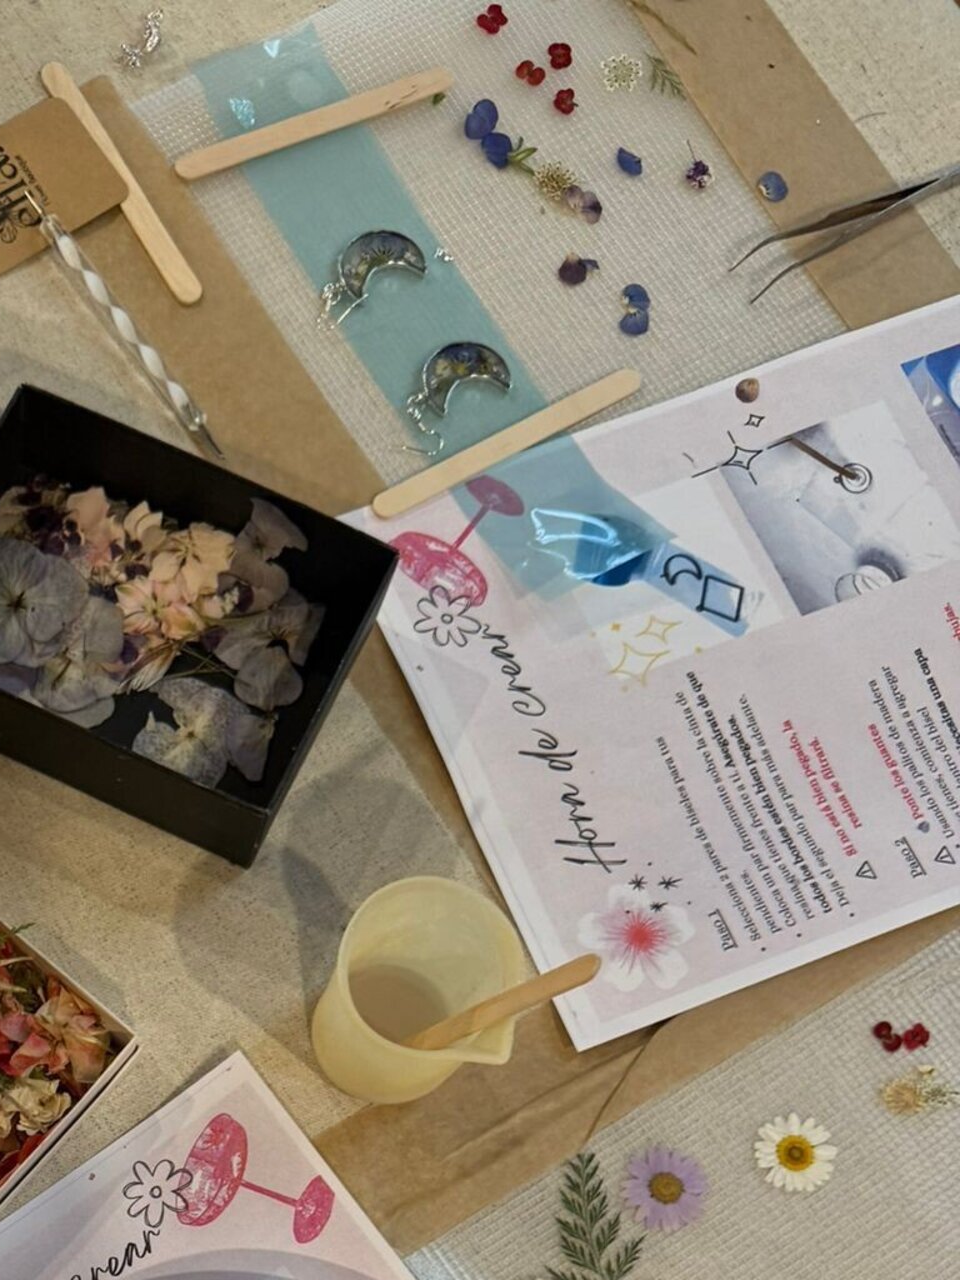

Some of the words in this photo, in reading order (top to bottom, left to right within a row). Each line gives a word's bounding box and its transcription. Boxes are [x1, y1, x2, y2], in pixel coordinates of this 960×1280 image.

[482, 622, 547, 717] crear
[913, 646, 932, 676] capa
[685, 670, 704, 693] que
[880, 665, 907, 710] agregar
[925, 675, 942, 701] una
[674, 691, 688, 707] de
[695, 692, 710, 709] de
[867, 678, 894, 725] madera
[738, 693, 767, 747] adelante.
[781, 718, 794, 733] la
[887, 724, 901, 741] de
[915, 705, 939, 736] bisel
[519, 727, 578, 771] de
[655, 735, 670, 757] tus
[695, 736, 708, 751] la
[703, 708, 736, 768] Asegúrate
[727, 713, 758, 767] pegados.
[867, 722, 898, 769] guantes
[905, 718, 939, 774] comienza
[929, 733, 948, 753] del
[664, 755, 686, 785] para
[701, 750, 723, 784] sobre
[760, 747, 778, 774] más
[788, 731, 818, 778] pegado,
[748, 765, 767, 796] bien
[771, 773, 794, 802] para
[808, 777, 828, 806] bien
[829, 780, 843, 794] se
[889, 768, 906, 788] los
[915, 778, 932, 799] los
[676, 784, 701, 828] biseles
[715, 784, 756, 853] firmemente
[739, 792, 764, 829] frente
[760, 792, 783, 826] estén
[784, 801, 805, 822] par
[819, 803, 841, 828] está
[837, 793, 863, 830] resina
[899, 786, 925, 821] Ponte
[925, 796, 956, 839] Usando
[554, 783, 627, 874] Hora
[693, 826, 708, 842] de
[835, 827, 851, 845] no
[893, 835, 909, 847] 2
[702, 841, 729, 874] pares
[757, 828, 783, 864] tienes
[776, 825, 805, 866] bordes
[795, 821, 829, 868] segundo
[749, 852, 770, 873] par
[798, 862, 815, 883] los
[819, 867, 835, 880] el
[900, 843, 925, 879] Paso
[718, 872, 730, 882] 2
[761, 871, 776, 889] un
[739, 868, 783, 935] pendientes.
[770, 887, 797, 928] Coloca
[808, 880, 833, 914] todos
[829, 879, 851, 908] Deja
[706, 907, 723, 918] 1
[724, 880, 762, 942] Selecciona
[712, 916, 738, 952] Paso
